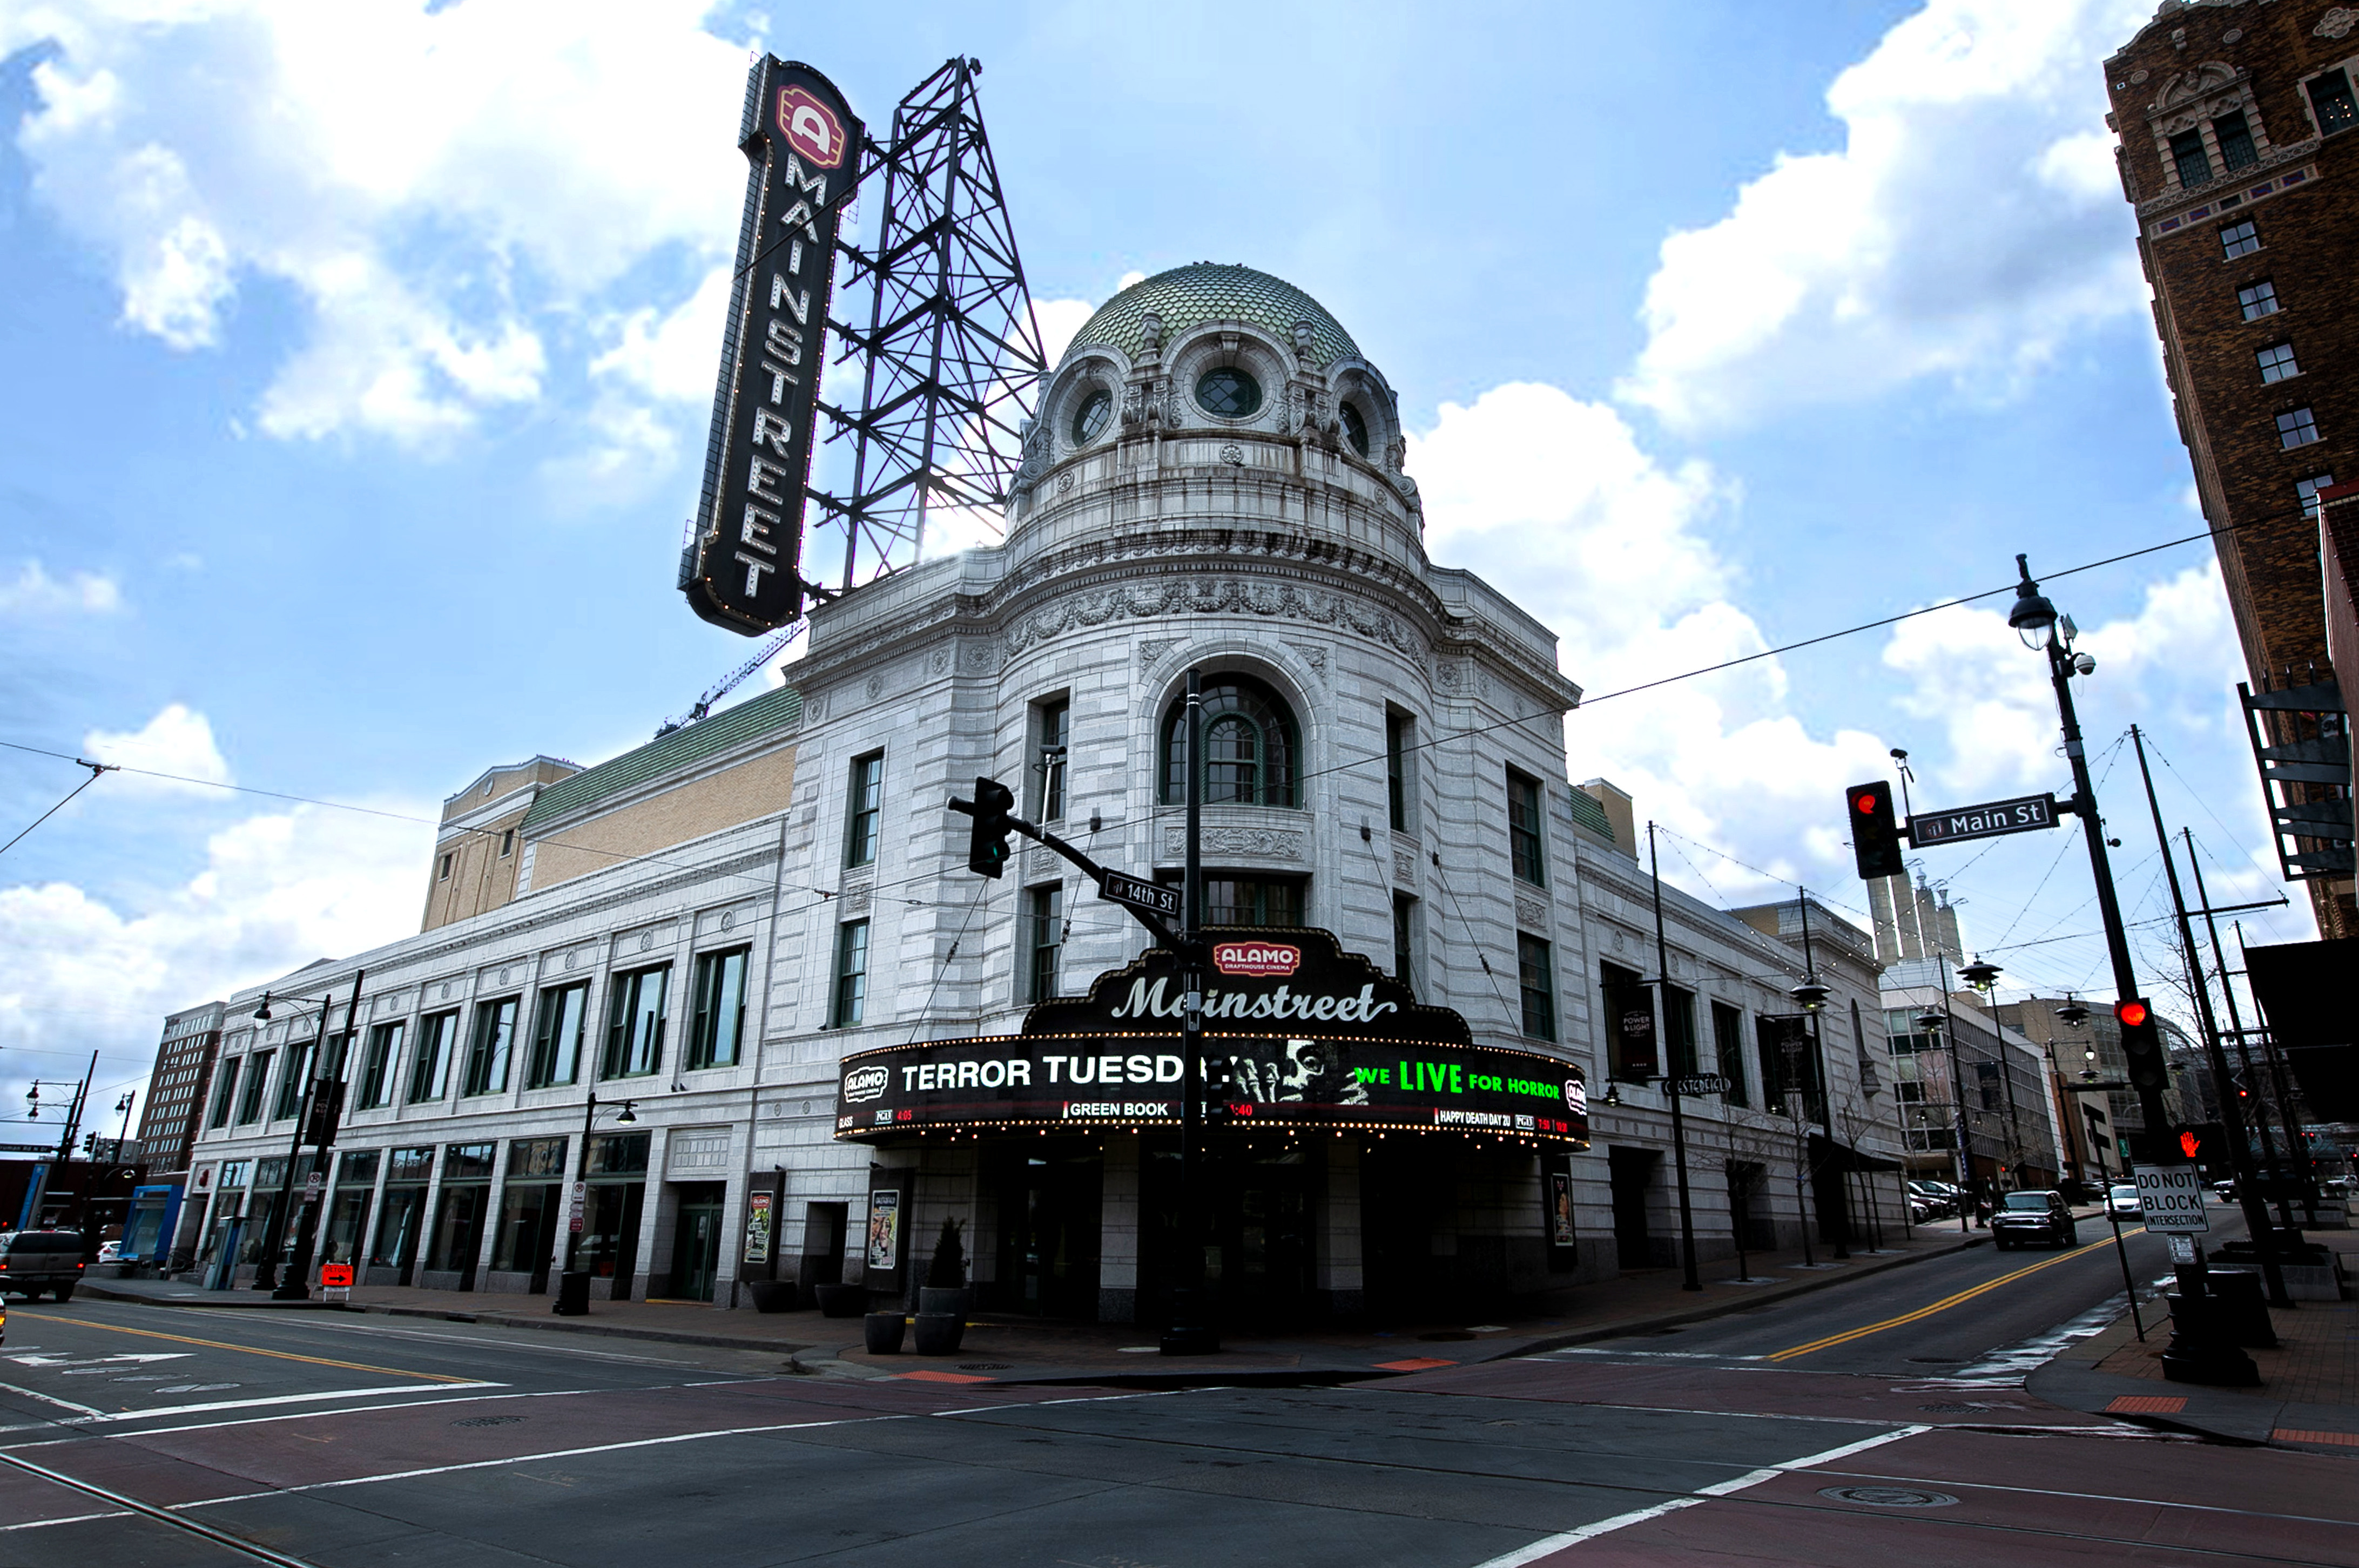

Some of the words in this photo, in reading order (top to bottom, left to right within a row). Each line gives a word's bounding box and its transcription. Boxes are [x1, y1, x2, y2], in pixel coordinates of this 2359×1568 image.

[736, 153, 827, 598] MAINSTREET
[1951, 810, 2007, 834] Main
[2017, 804, 2040, 823] St
[1128, 883, 1155, 904] 14th
[1160, 894, 1173, 910] St
[1222, 949, 1293, 964] ALAMO
[1623, 1016, 1650, 1025] POWER
[1629, 1023, 1650, 1031] LIGHT
[847, 1071, 884, 1091] ALAMO
[902, 1059, 1032, 1091] TERROR
[1043, 1055, 1238, 1084] TUESD
[1354, 1067, 1390, 1084] WE
[1400, 1061, 1462, 1094] LIVE
[1469, 1074, 1502, 1092] FOR
[1508, 1078, 1560, 1100] HORROR
[1664, 1077, 1732, 1095] CESTERFIELD
[1070, 1103, 1121, 1116] GREEN
[1124, 1103, 1168, 1116] BOOK
[1440, 1110, 1464, 1124] HAPPY
[1465, 1111, 1488, 1125] DEATH
[1489, 1113, 1502, 1125] DAY
[2138, 1174, 2160, 1189] DO
[2162, 1173, 2193, 1188] NOT
[2142, 1195, 2201, 1211] BLOCK
[2147, 1215, 2205, 1226] INTERSECTION
